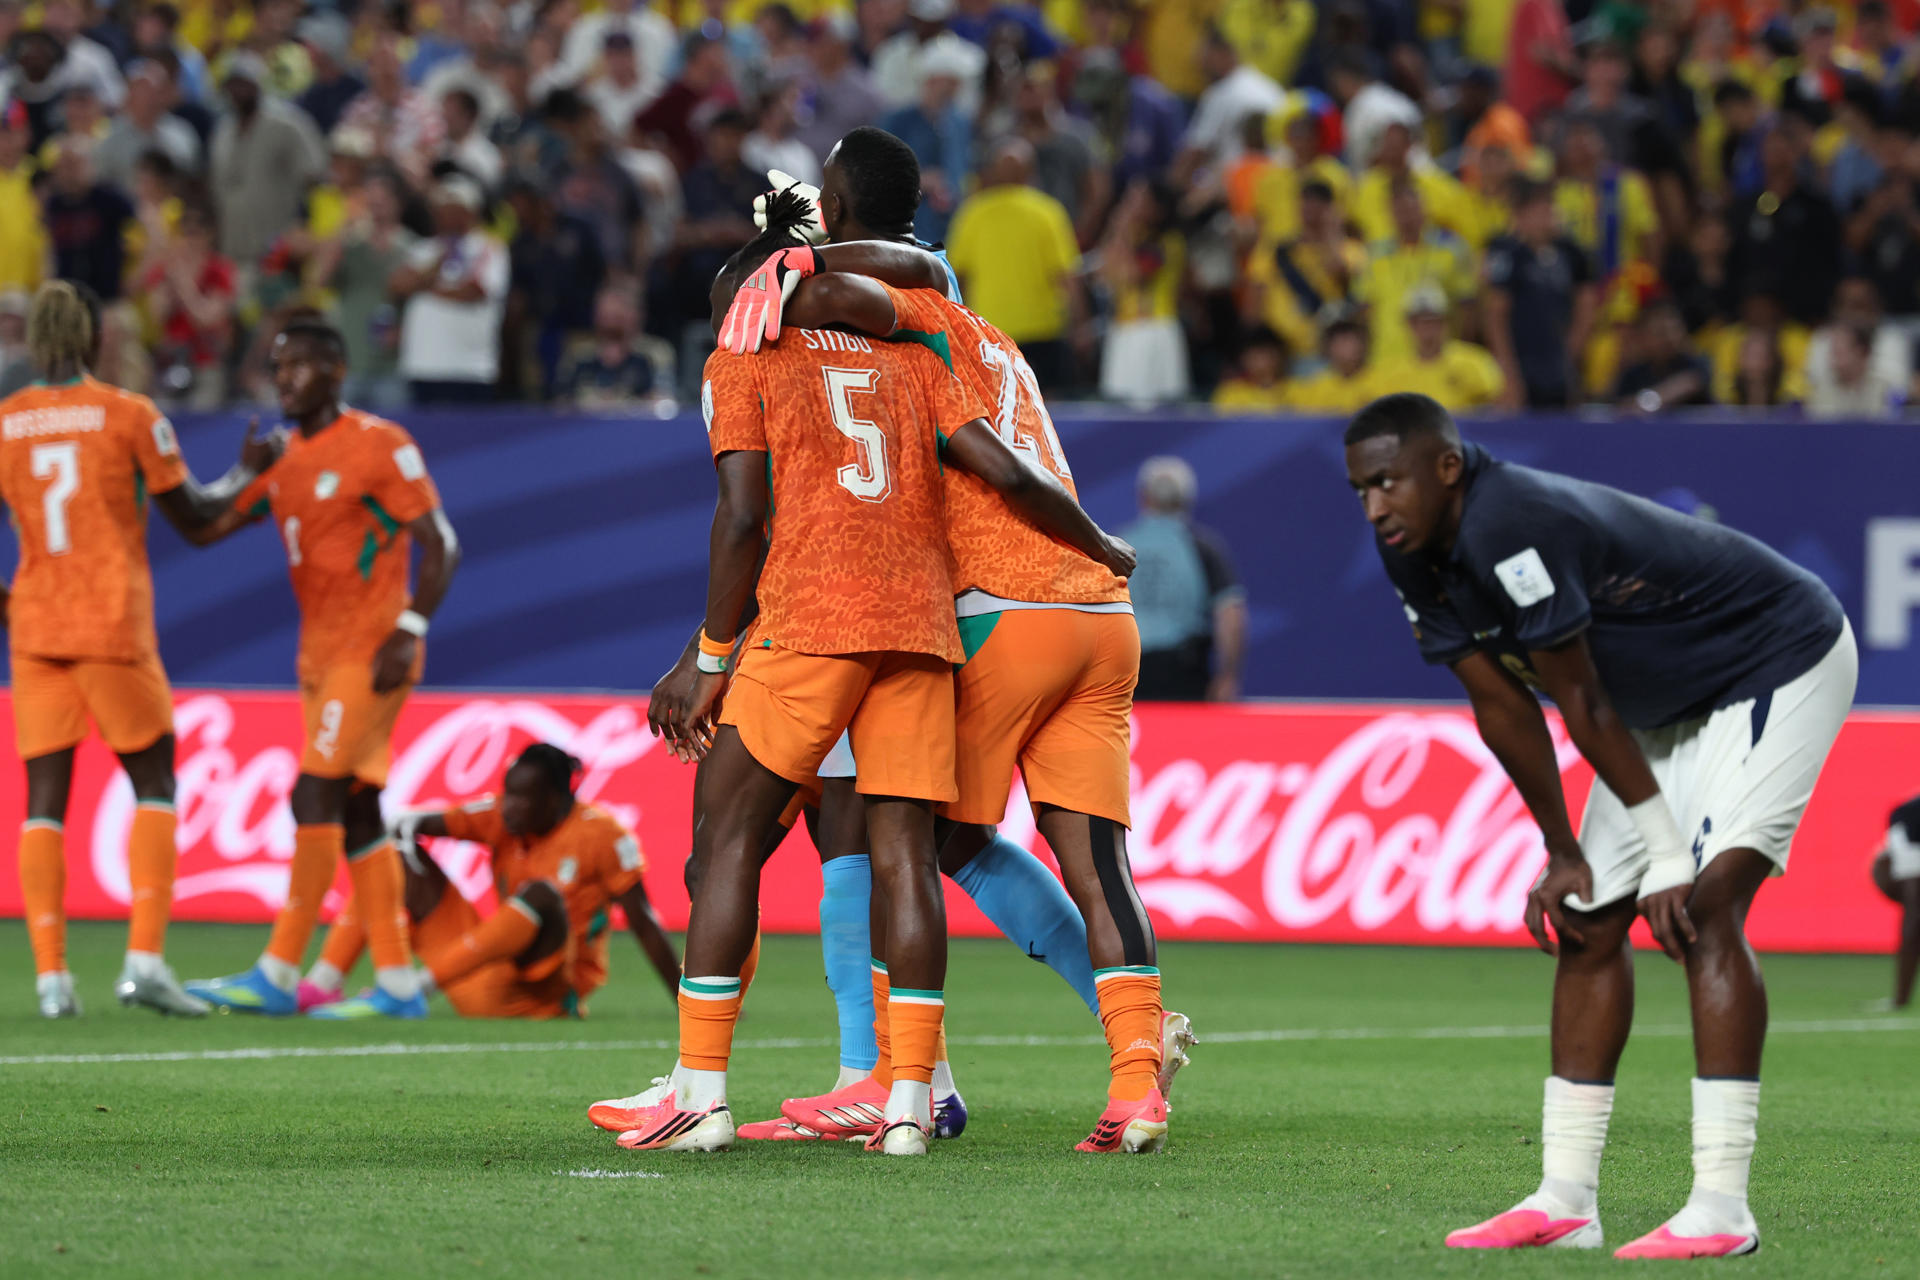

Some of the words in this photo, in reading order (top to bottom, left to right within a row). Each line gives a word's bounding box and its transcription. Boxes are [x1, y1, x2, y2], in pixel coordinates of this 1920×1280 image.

[800, 328, 873, 354] SINGO
[30, 440, 82, 557] 7
[821, 365, 892, 504] 5
[997, 711, 1582, 932] ca-Cola
